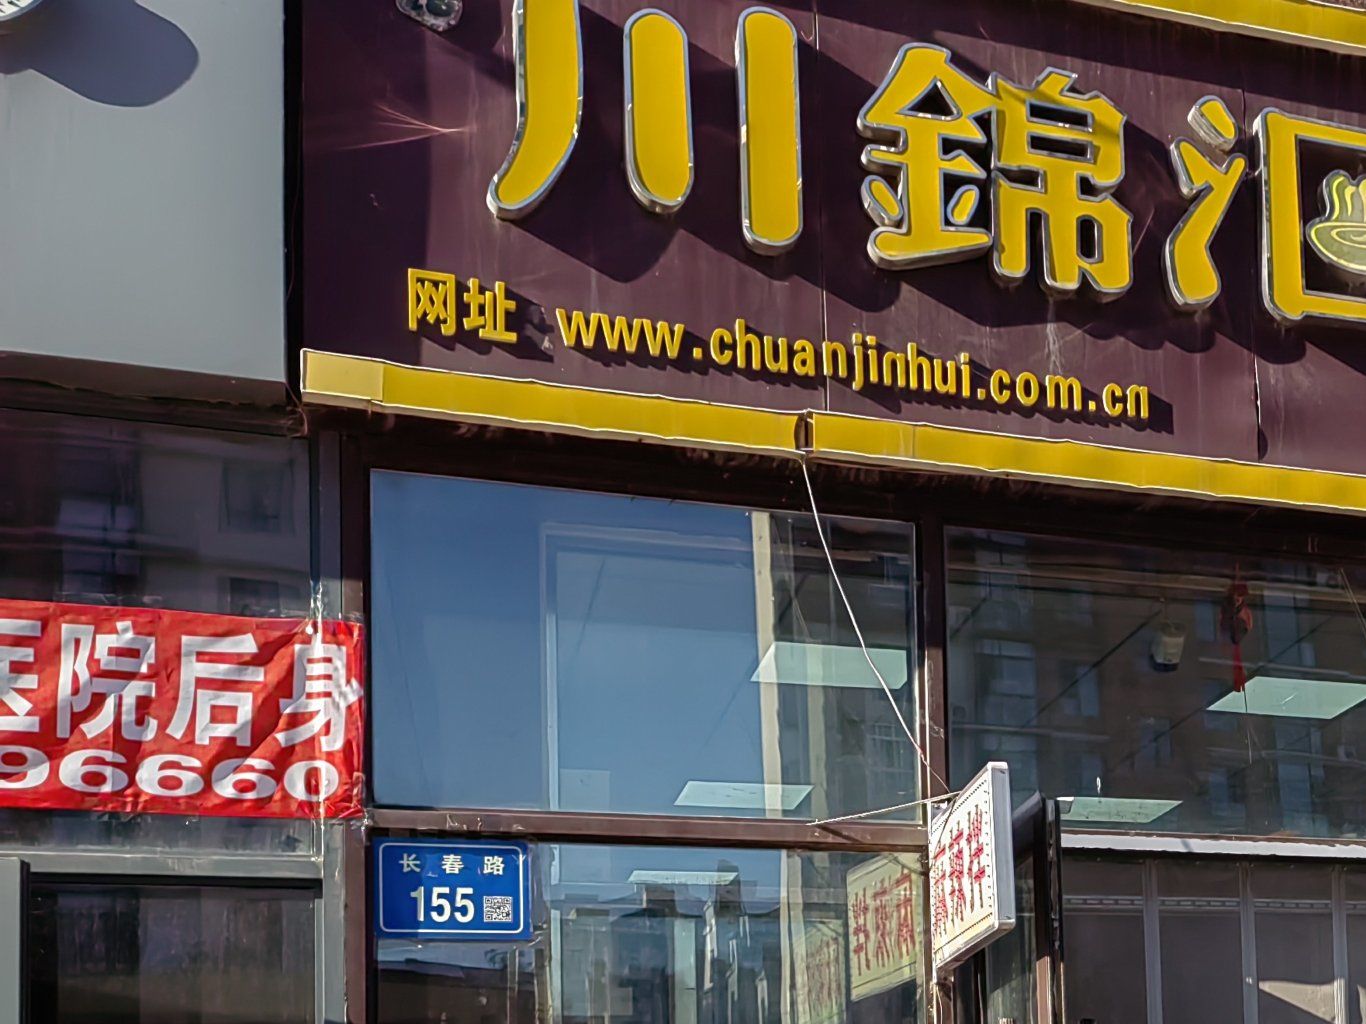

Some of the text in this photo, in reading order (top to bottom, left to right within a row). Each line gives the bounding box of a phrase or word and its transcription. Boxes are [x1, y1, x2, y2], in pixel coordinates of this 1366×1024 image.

[406, 268, 1150, 420] 网址 www.chuanjinhui.com.cn
[398, 853, 505, 875] 长春路
[410, 886, 475, 923] 155
